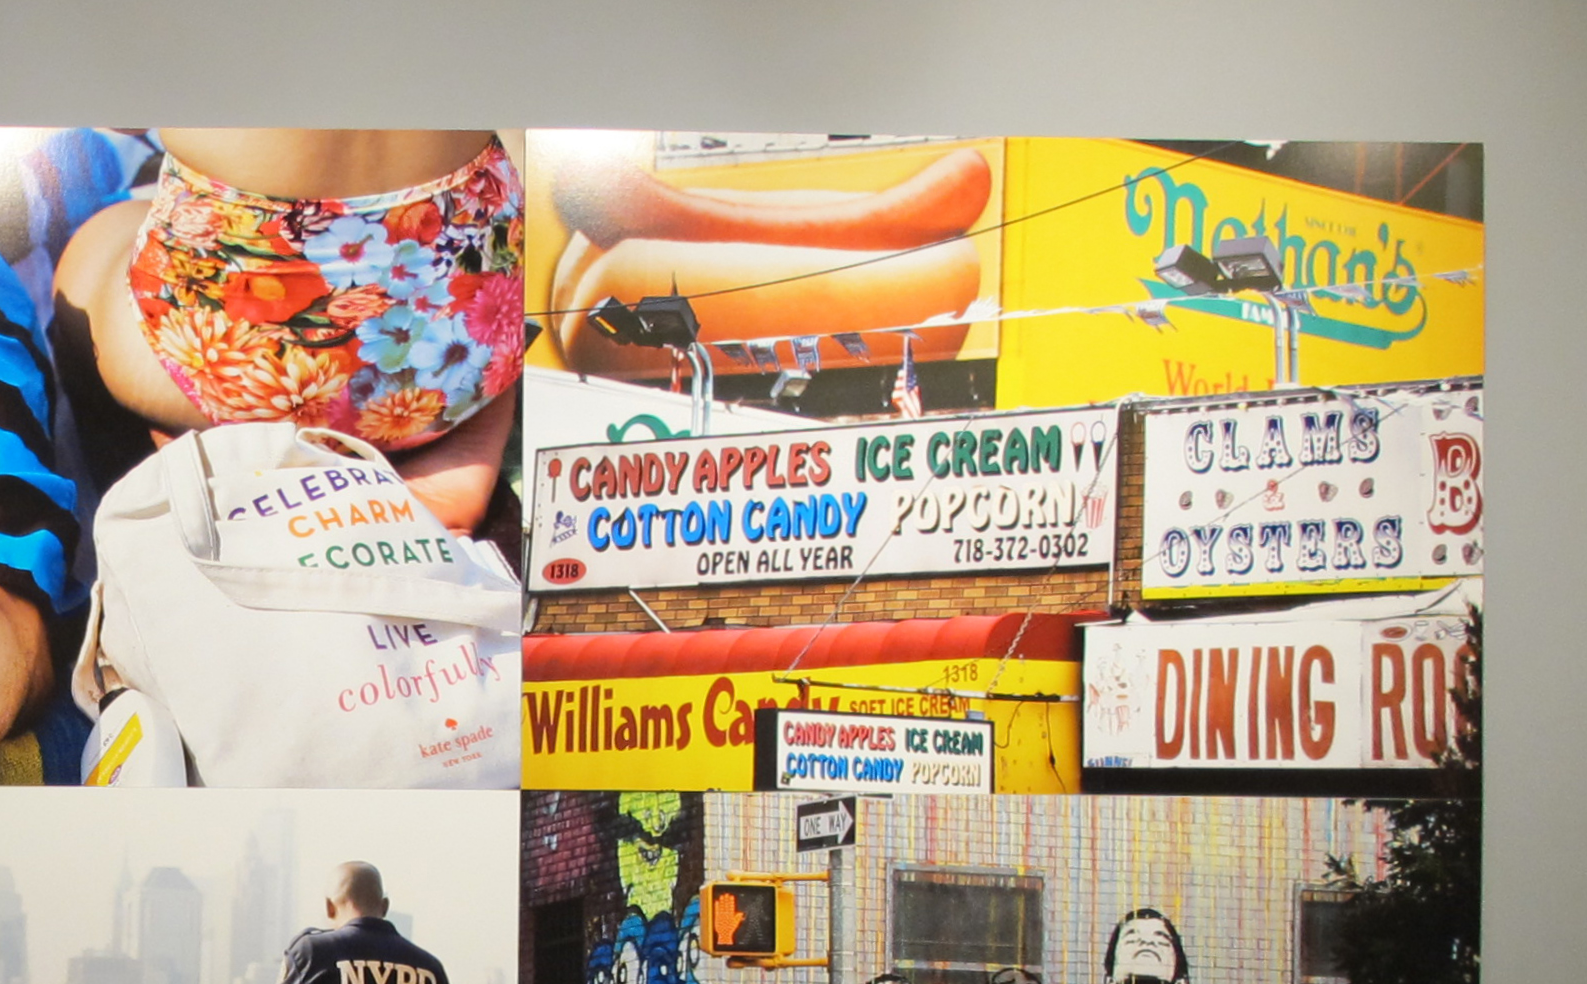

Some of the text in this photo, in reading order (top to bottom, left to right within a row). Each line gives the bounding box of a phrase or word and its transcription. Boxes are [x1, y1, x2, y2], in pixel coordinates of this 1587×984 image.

[855, 425, 1062, 483] ICE CREAM
[1183, 408, 1381, 474] CLAMS
[569, 441, 832, 502] CANDY APPLES
[288, 499, 416, 538] CHARM
[587, 491, 867, 552] COTTON CANDY
[891, 482, 1075, 536] POPCORN
[696, 545, 854, 576] OPEN ALL YEAR
[953, 533, 1089, 564] 718-372-0302
[1158, 515, 1403, 578] OYSTERS
[550, 563, 580, 580] 1318
[367, 624, 438, 650] LIVE
[338, 641, 501, 712] colorfully
[943, 663, 978, 683] 1318
[522, 684, 693, 755] Williams
[849, 694, 971, 717] SOFT ICE CREAM
[1155, 646, 1336, 761] DINING
[418, 725, 494, 758] kate spade
[783, 720, 984, 756] CANDY APPLES ICE CREAM
[786, 752, 982, 787] COTTON CANDY POPCORN
[803, 813, 847, 837] ONE WAY
